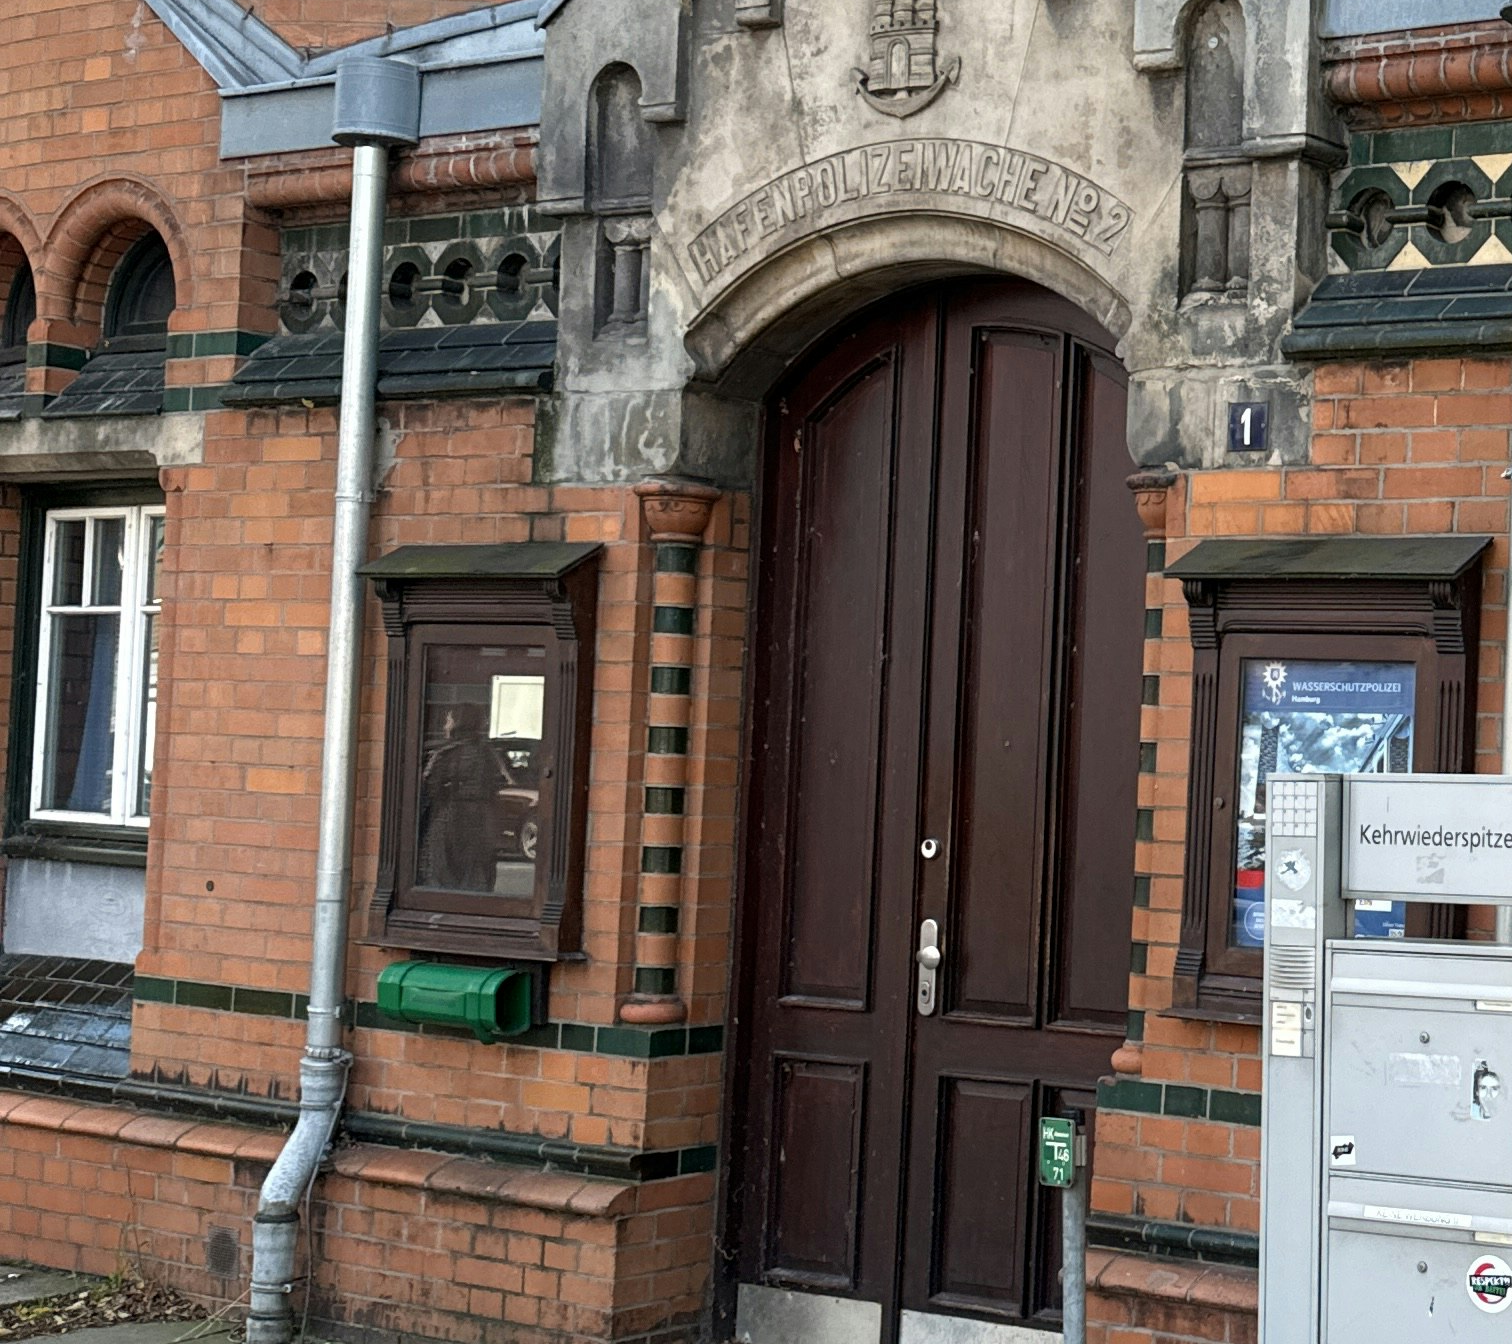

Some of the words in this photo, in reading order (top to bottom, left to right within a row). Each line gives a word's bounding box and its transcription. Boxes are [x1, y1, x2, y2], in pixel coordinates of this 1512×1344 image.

[690, 141, 1048, 285] HAFENPOLIZEIWACHE
[1101, 207, 1131, 258] 2
[1240, 407, 1252, 446] 1
[1292, 681, 1402, 693] WASSERSCHUTZPOLIZEI
[1291, 695, 1321, 705] Hamburg
